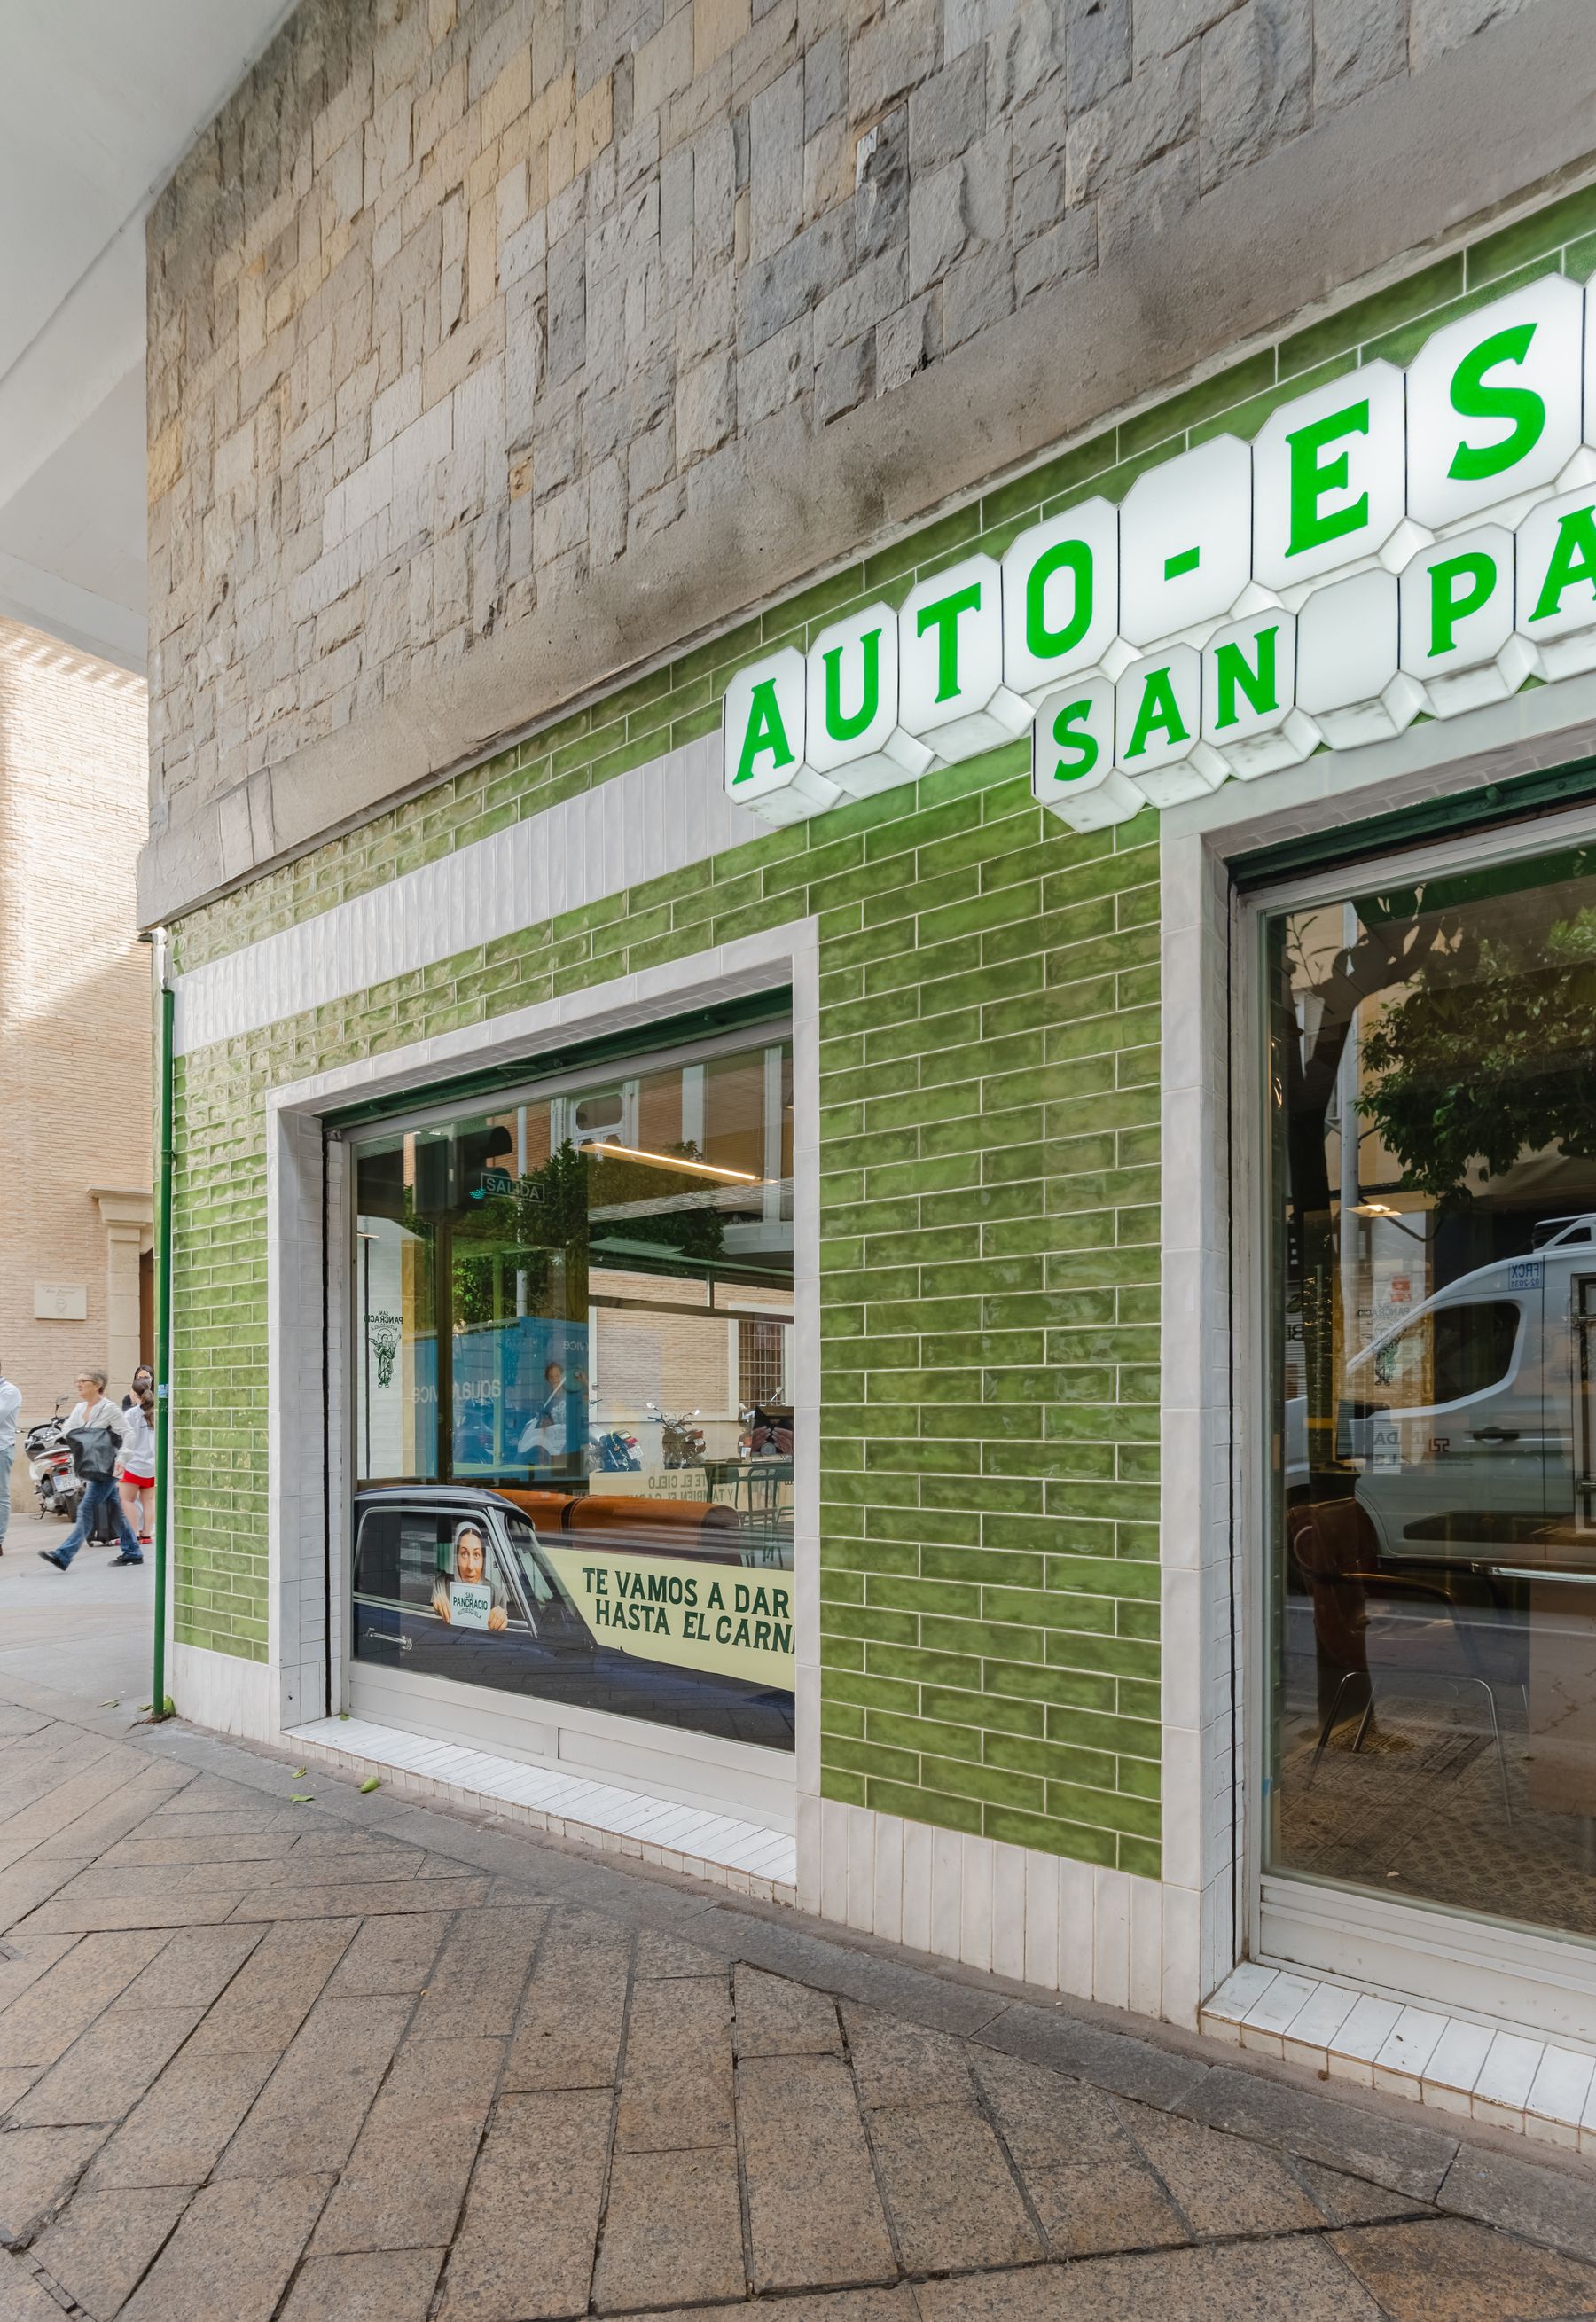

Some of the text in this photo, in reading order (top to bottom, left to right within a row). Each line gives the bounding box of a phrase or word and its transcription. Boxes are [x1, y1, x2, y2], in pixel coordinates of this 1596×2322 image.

[1053, 626, 1279, 782] SAN
[486, 1177, 540, 1200] SALIDA
[453, 1596, 488, 1611] PANCRACIO
[582, 1568, 790, 1619] TE VAMOS A DAR
[596, 1599, 671, 1636] HASTA
[682, 1610, 710, 1641] EL
